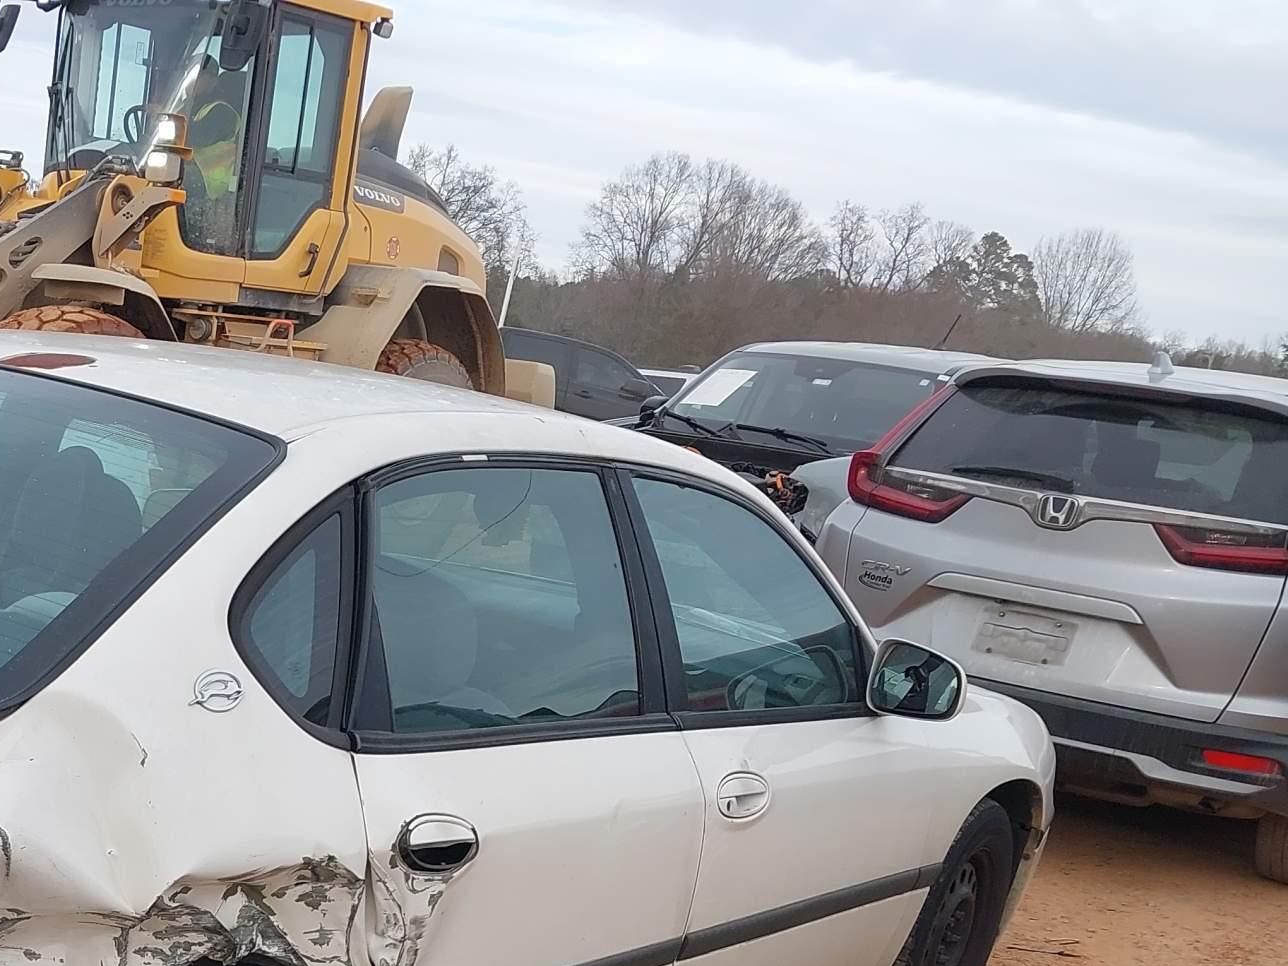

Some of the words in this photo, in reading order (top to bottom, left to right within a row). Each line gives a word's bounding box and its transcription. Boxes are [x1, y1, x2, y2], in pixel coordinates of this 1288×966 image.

[353, 185, 401, 207] VOLVO
[861, 559, 912, 576] CR-V
[863, 570, 893, 585] Honda
